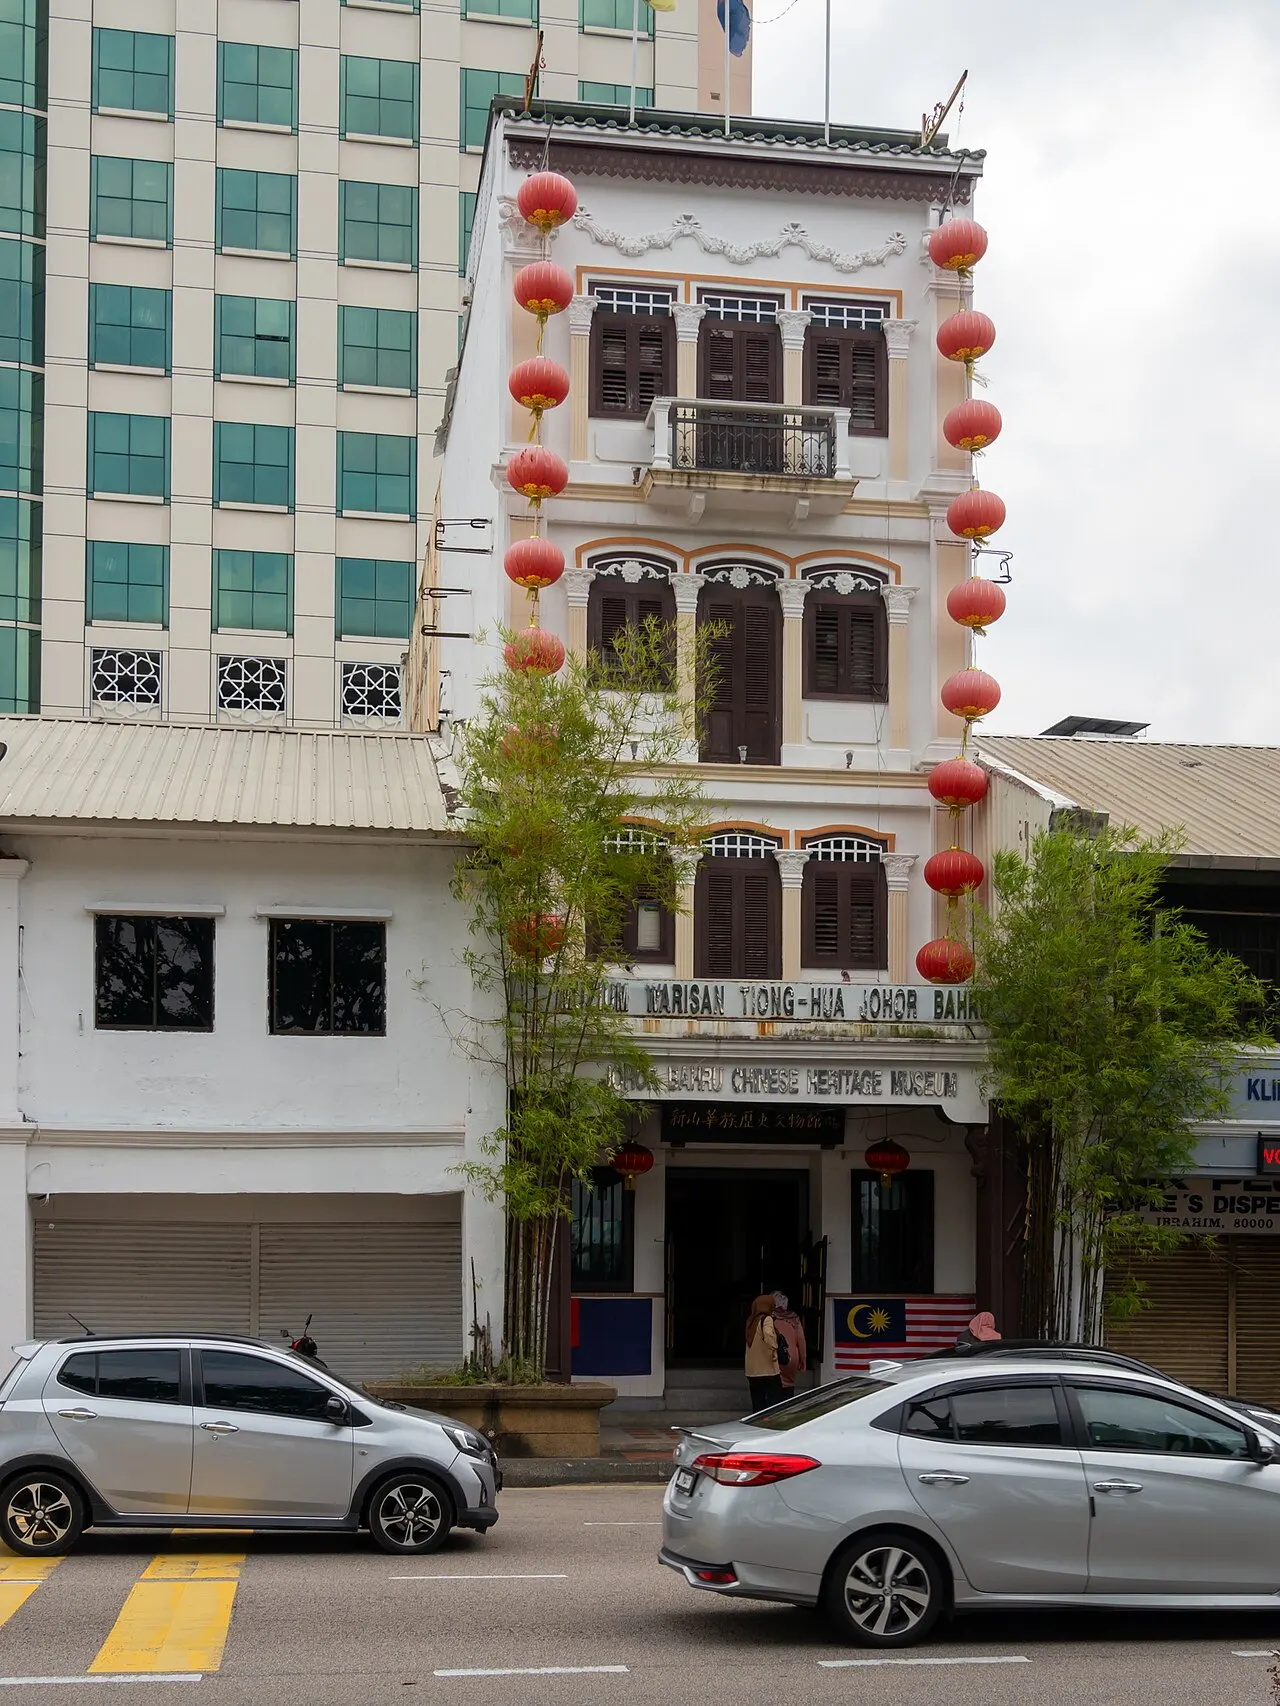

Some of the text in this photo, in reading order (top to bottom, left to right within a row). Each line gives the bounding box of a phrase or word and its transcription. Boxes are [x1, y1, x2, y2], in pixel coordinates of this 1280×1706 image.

[645, 983, 725, 1015] WARISAN
[740, 985, 845, 1018] TIONG-HUA
[859, 988, 917, 1019] JOHOR
[933, 988, 982, 1020] BAHR
[667, 1065, 725, 1093] BAHRU
[731, 1067, 799, 1094] CHINESE
[806, 1068, 882, 1096] HERITAGE
[890, 1070, 958, 1098] MUSEUM
[1247, 1078, 1280, 1101] KLI
[1234, 1218, 1274, 1229] 80000
